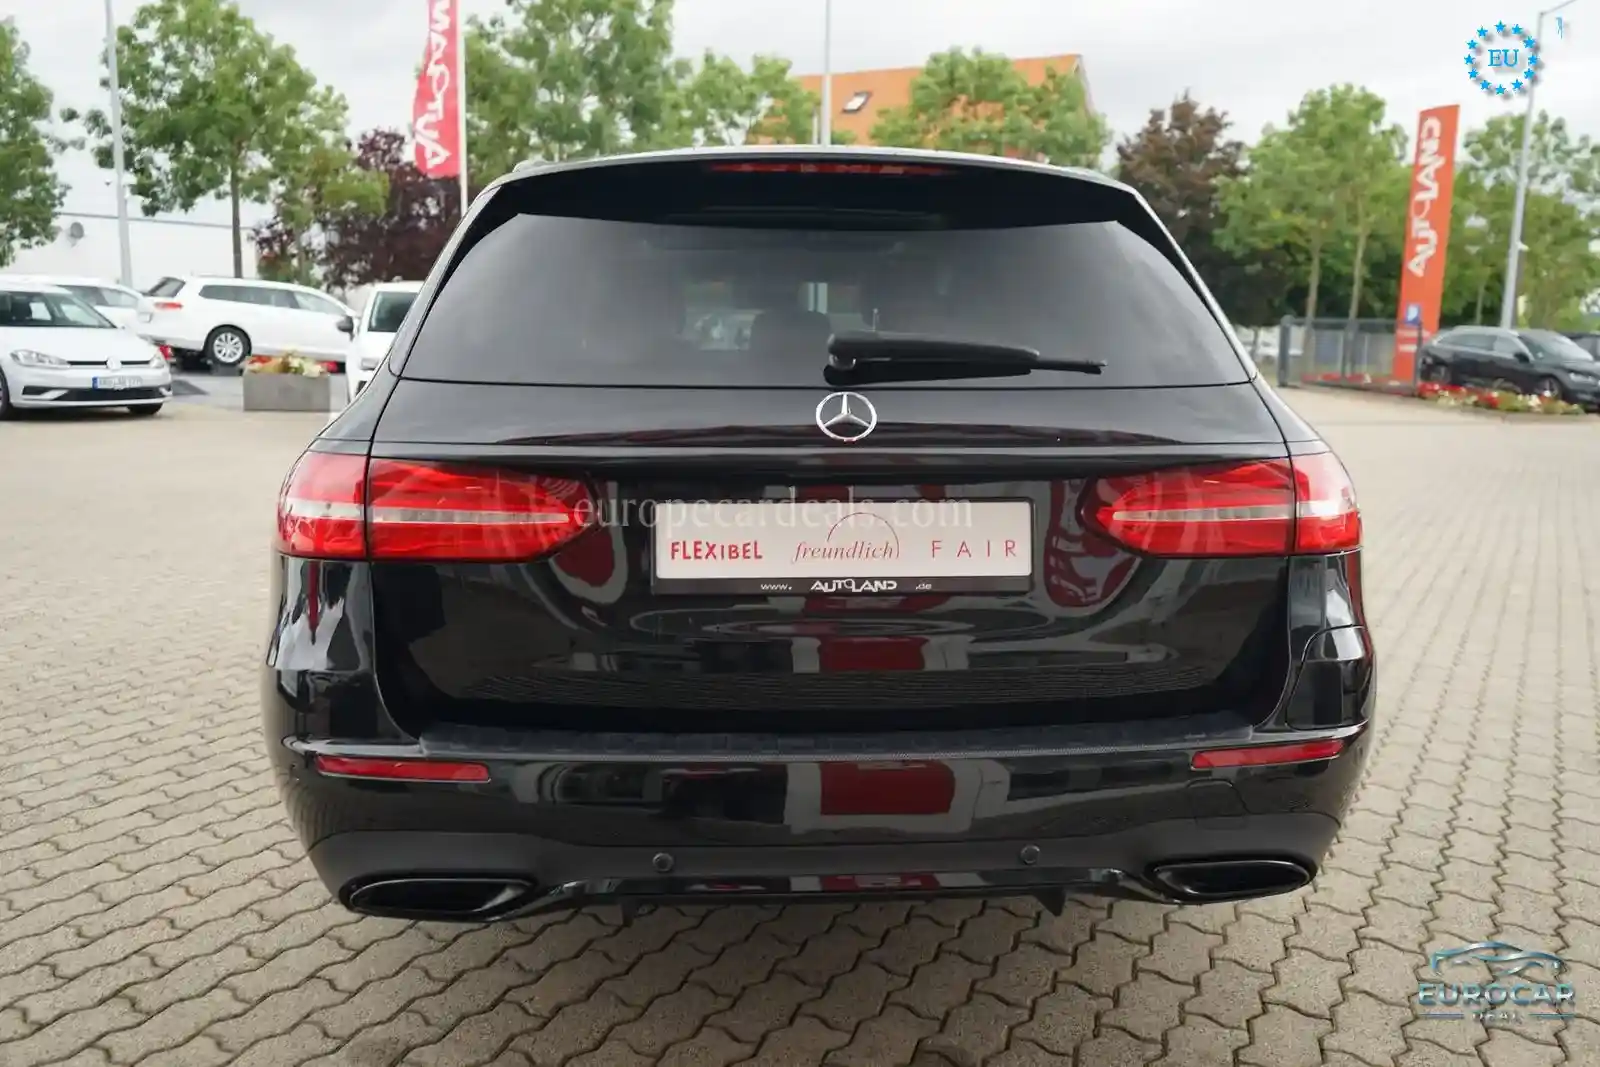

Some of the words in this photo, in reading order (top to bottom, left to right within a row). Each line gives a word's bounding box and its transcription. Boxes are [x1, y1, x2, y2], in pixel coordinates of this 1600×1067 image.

[670, 540, 763, 560] FLEXIBEL
[791, 541, 894, 564] freundlich
[932, 540, 1017, 558] FAIR
[810, 579, 898, 593] AUTOLAND
[915, 582, 932, 591] .de
